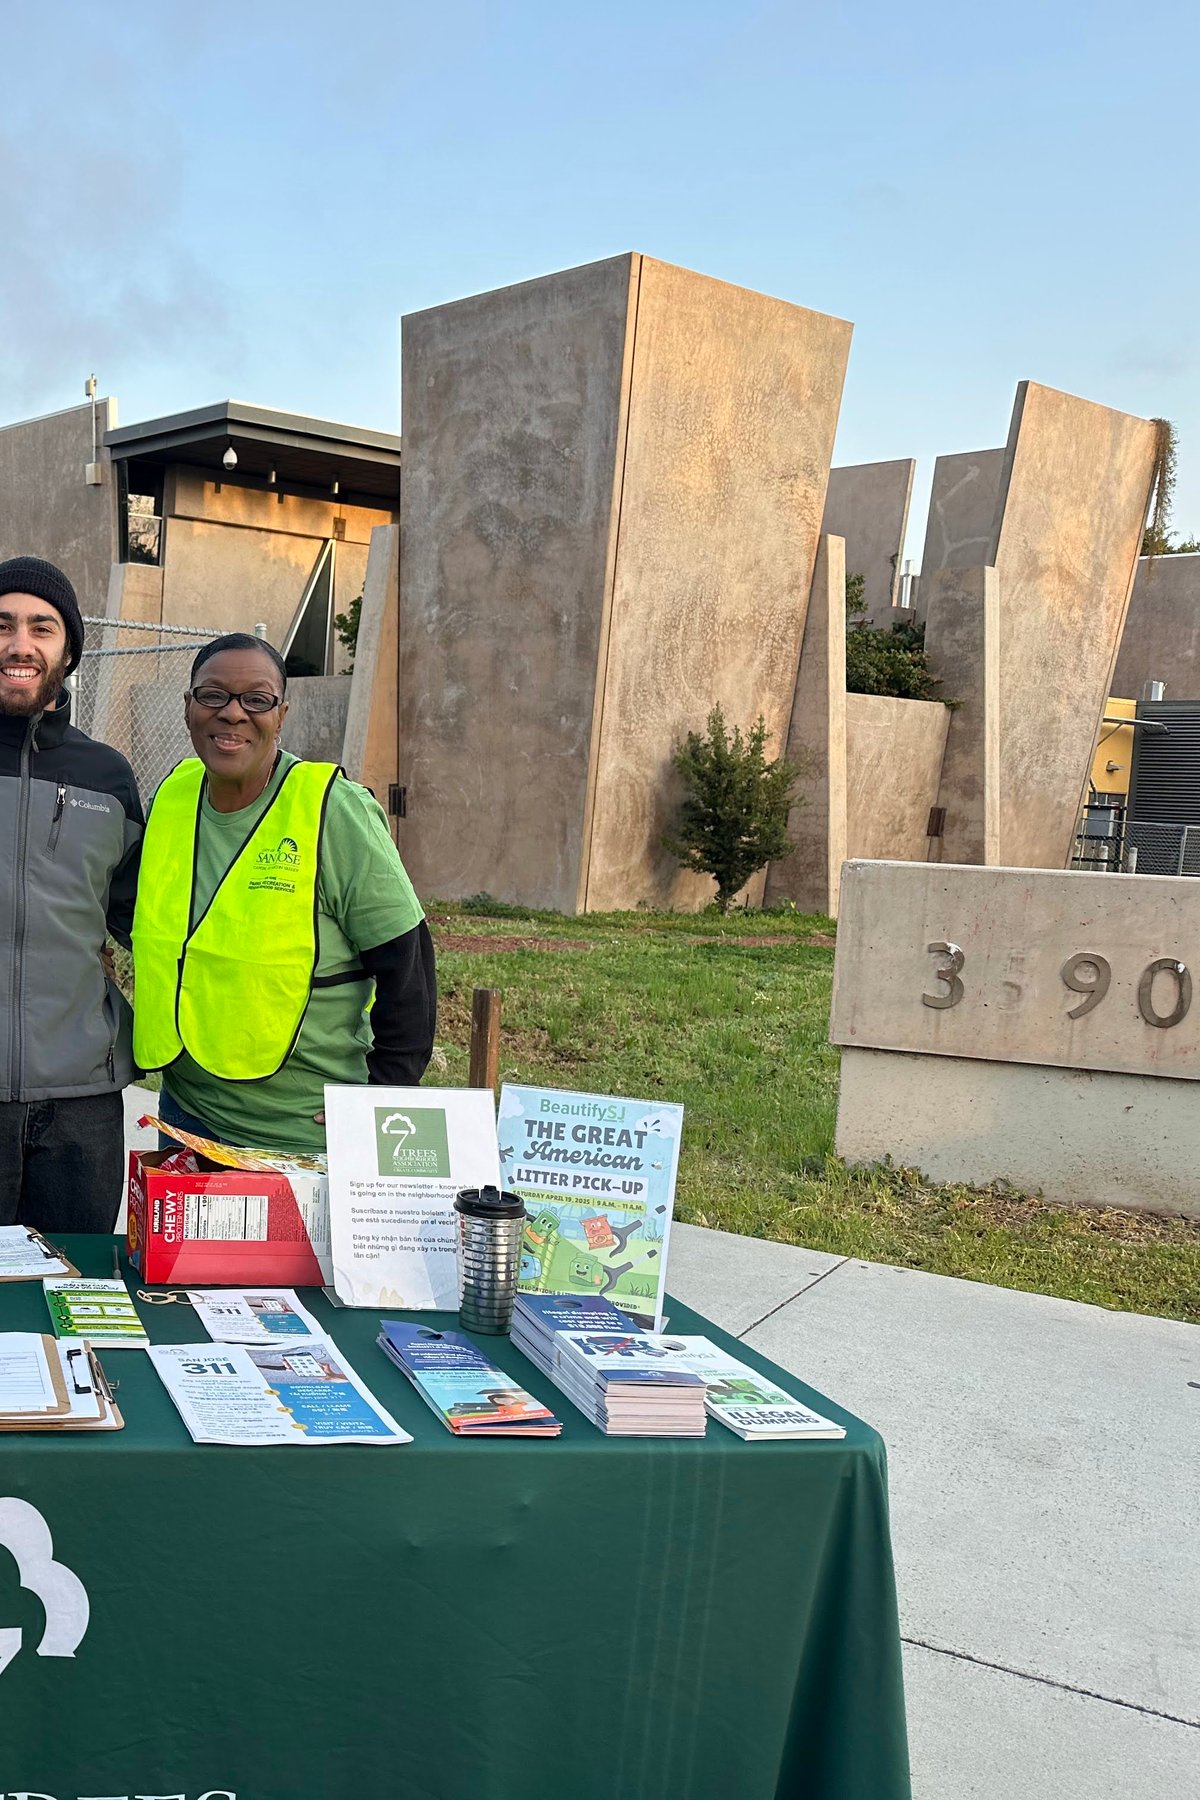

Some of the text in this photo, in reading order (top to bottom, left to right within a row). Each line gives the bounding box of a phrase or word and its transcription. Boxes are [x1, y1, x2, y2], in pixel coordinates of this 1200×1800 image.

[78, 800, 110, 813] Columbia
[256, 852, 275, 863] SAN
[540, 1099, 626, 1121] BeautifySJ
[390, 1130, 437, 1157] 7 TREES
[525, 1119, 648, 1149] THE GREAT
[523, 1140, 643, 1171] American
[517, 1168, 643, 1195] LITTER PICK-UP
[512, 1190, 545, 1199] SATURDAY
[546, 1193, 564, 1201] APRIL
[164, 1189, 176, 1243] CHEWY
[182, 1363, 237, 1374] 311
[727, 1410, 812, 1419] ILLEGAL
